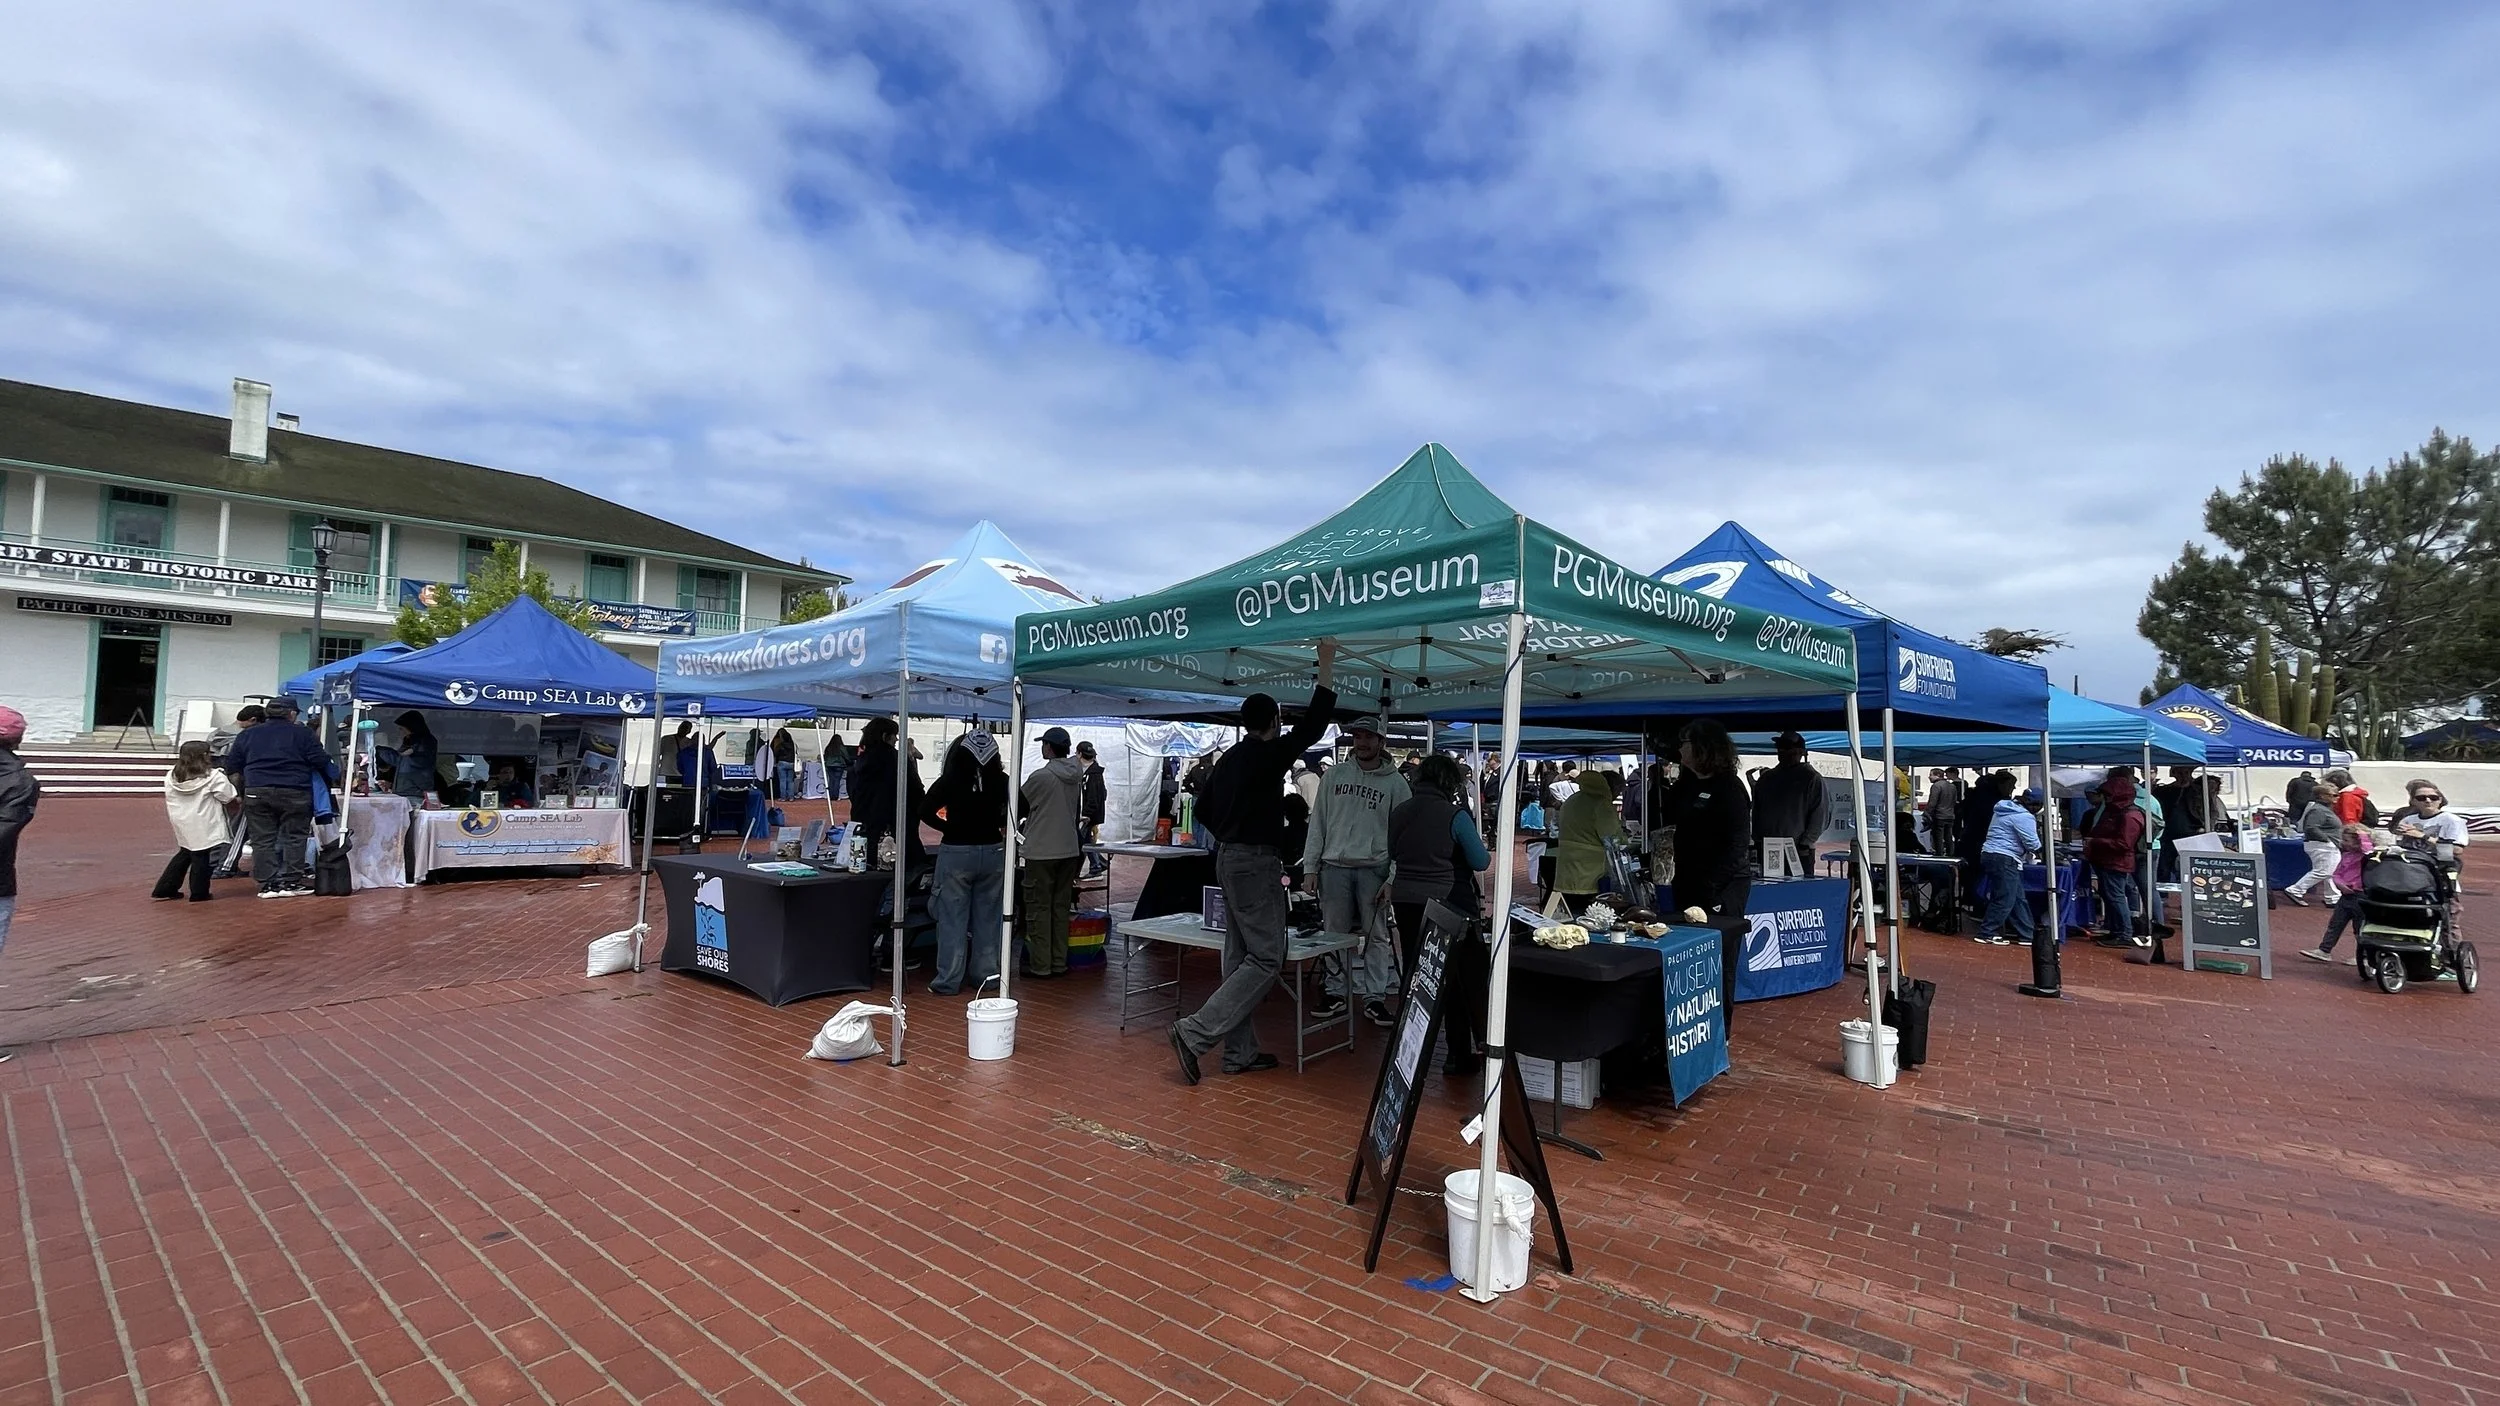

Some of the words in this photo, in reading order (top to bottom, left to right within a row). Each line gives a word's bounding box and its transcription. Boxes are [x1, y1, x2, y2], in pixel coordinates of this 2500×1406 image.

[1346, 526, 1427, 538] GROVE
[51, 552, 131, 571] STATE
[142, 560, 257, 583] HISTORIC
[1235, 553, 1479, 628] @PGMuseum
[1553, 543, 1737, 643] PGMuseum.org
[22, 598, 88, 613] PACIFIC
[95, 604, 150, 618] HOUSE
[156, 609, 228, 625] MUSEUM
[1028, 605, 1190, 655] PGMuseum.org
[675, 626, 866, 668] saveourshores.org
[1756, 615, 1847, 669] @PGMuseum
[1916, 651, 1956, 683] SURFRIDER
[482, 684, 538, 706] Camp
[542, 688, 580, 704] SEA
[585, 691, 617, 707] Lab
[1917, 679, 1957, 701] FOUNDATION
[2159, 705, 2222, 725] LIFORNIA
[2241, 749, 2305, 762] PARKS
[1335, 783, 1385, 804] MONTEREY
[1368, 801, 1377, 810] CA
[505, 814, 537, 827] Camp
[539, 814, 560, 823] SEA
[563, 814, 583, 823] Lab
[2191, 866, 2213, 877] Prey
[1777, 908, 1825, 931] SURFRIDER
[1779, 930, 1827, 946] FOUNDATION
[696, 945, 712, 957] SAVE
[713, 949, 729, 962] OUR
[696, 954, 729, 973] SHORES
[1667, 948, 1693, 967] PACIFIC
[1696, 940, 1715, 956] GROVE
[1665, 954, 1722, 1001] MUSEUM
[1676, 987, 1720, 1027] NATURAL
[1667, 1018, 1711, 1058] HISTORY
